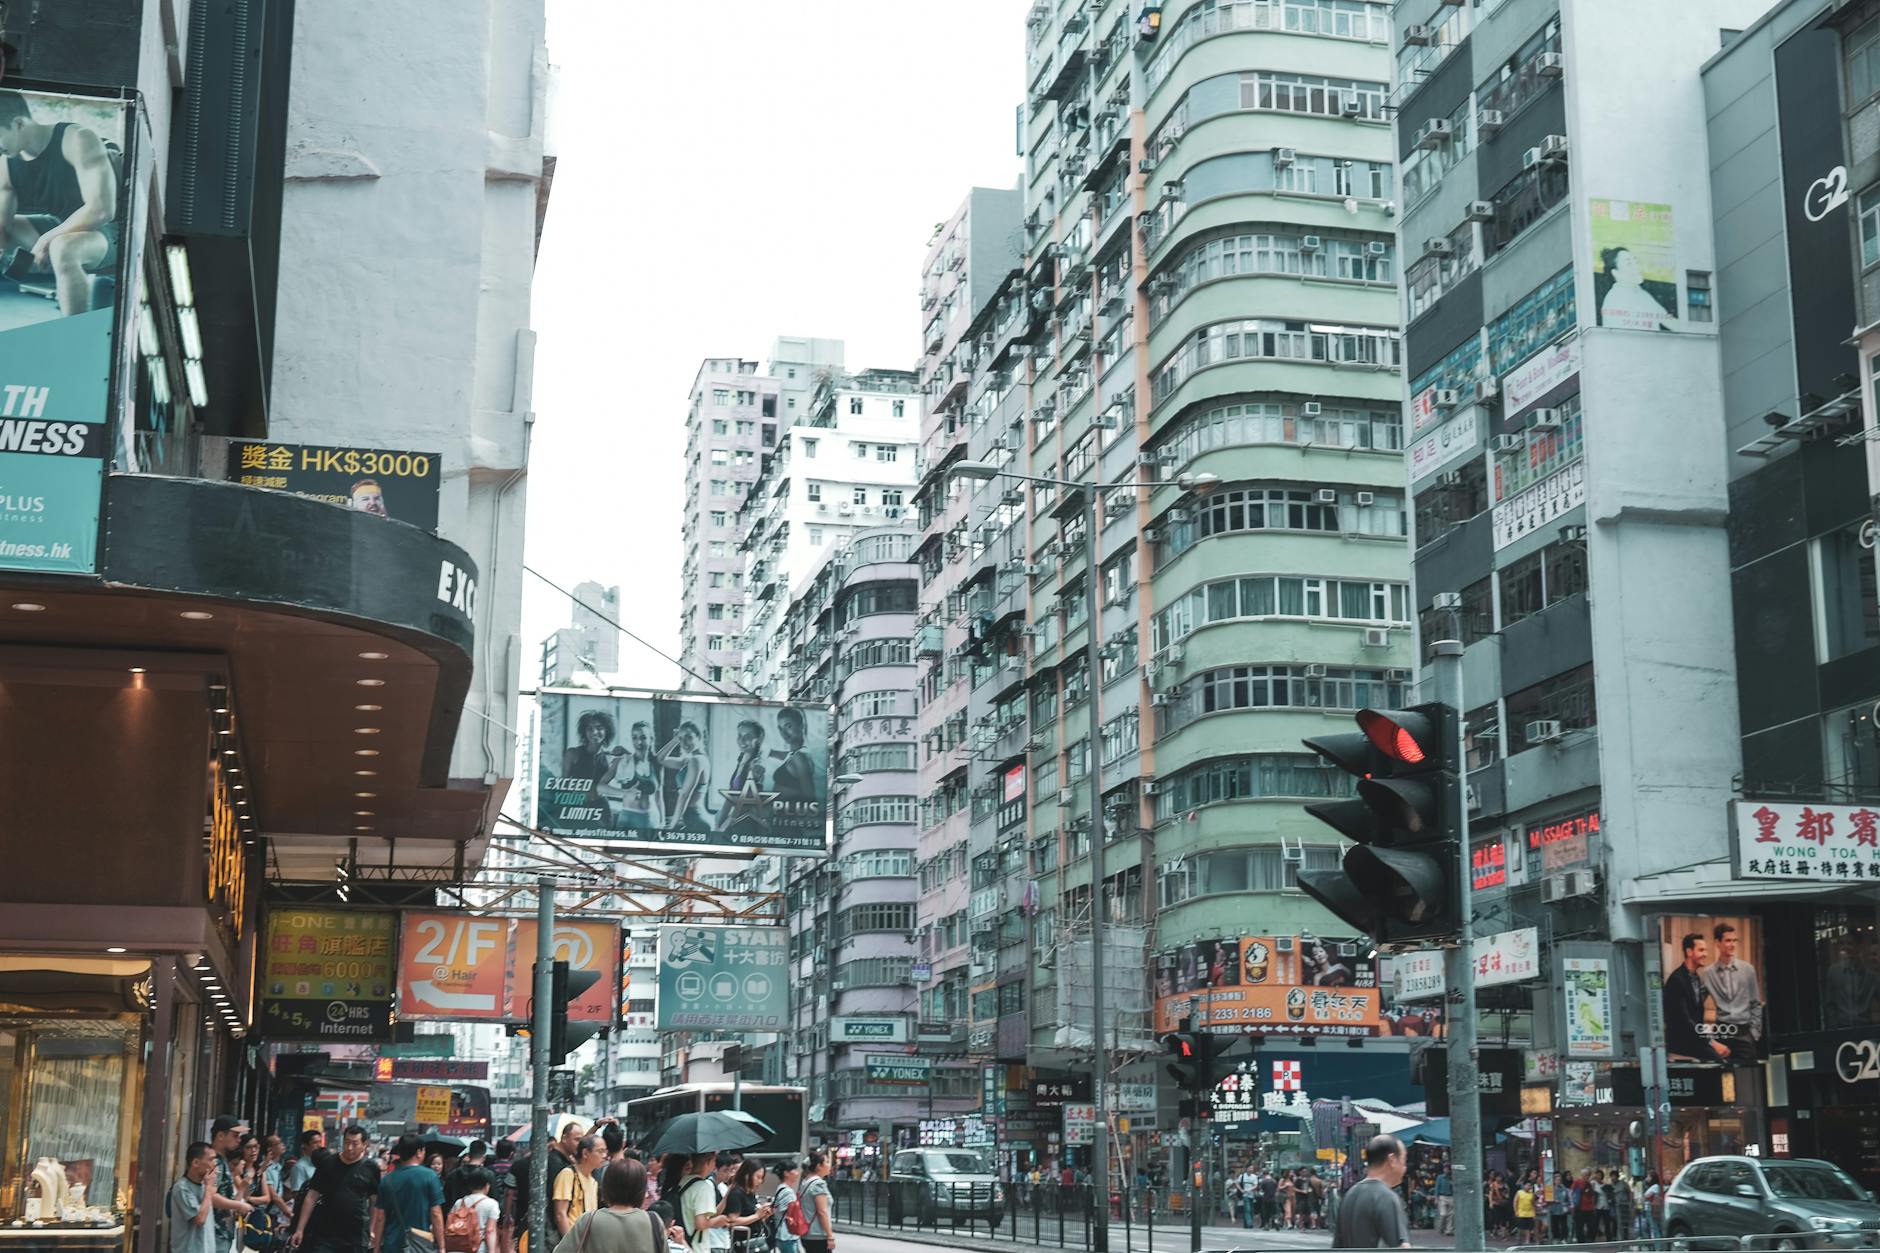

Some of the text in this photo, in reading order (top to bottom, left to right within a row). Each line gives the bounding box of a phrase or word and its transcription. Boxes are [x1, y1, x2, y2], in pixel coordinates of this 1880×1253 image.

[0, 419, 89, 456] NESS
[241, 445, 430, 477] 獎金 HK$3000
[544, 777, 593, 792] EXCEED
[554, 792, 586, 805] YOUR
[559, 806, 603, 821] LIMITS
[772, 801, 819, 817] PLUS
[1529, 820, 1574, 850] MSSAGE
[1773, 846, 1816, 858] WONG
[1829, 847, 1858, 859] TOA
[413, 919, 500, 966] 2/F
[723, 930, 785, 946] STAR
[451, 970, 478, 981] Hair
[348, 1006, 369, 1018] HRS
[1215, 1007, 1272, 1020] 2331 2186
[320, 1022, 373, 1034] Internet
[864, 1024, 889, 1034] YONEX
[1695, 1023, 1738, 1035] G2000
[1835, 1040, 1880, 1084] G2
[892, 1067, 924, 1080] YONEX
